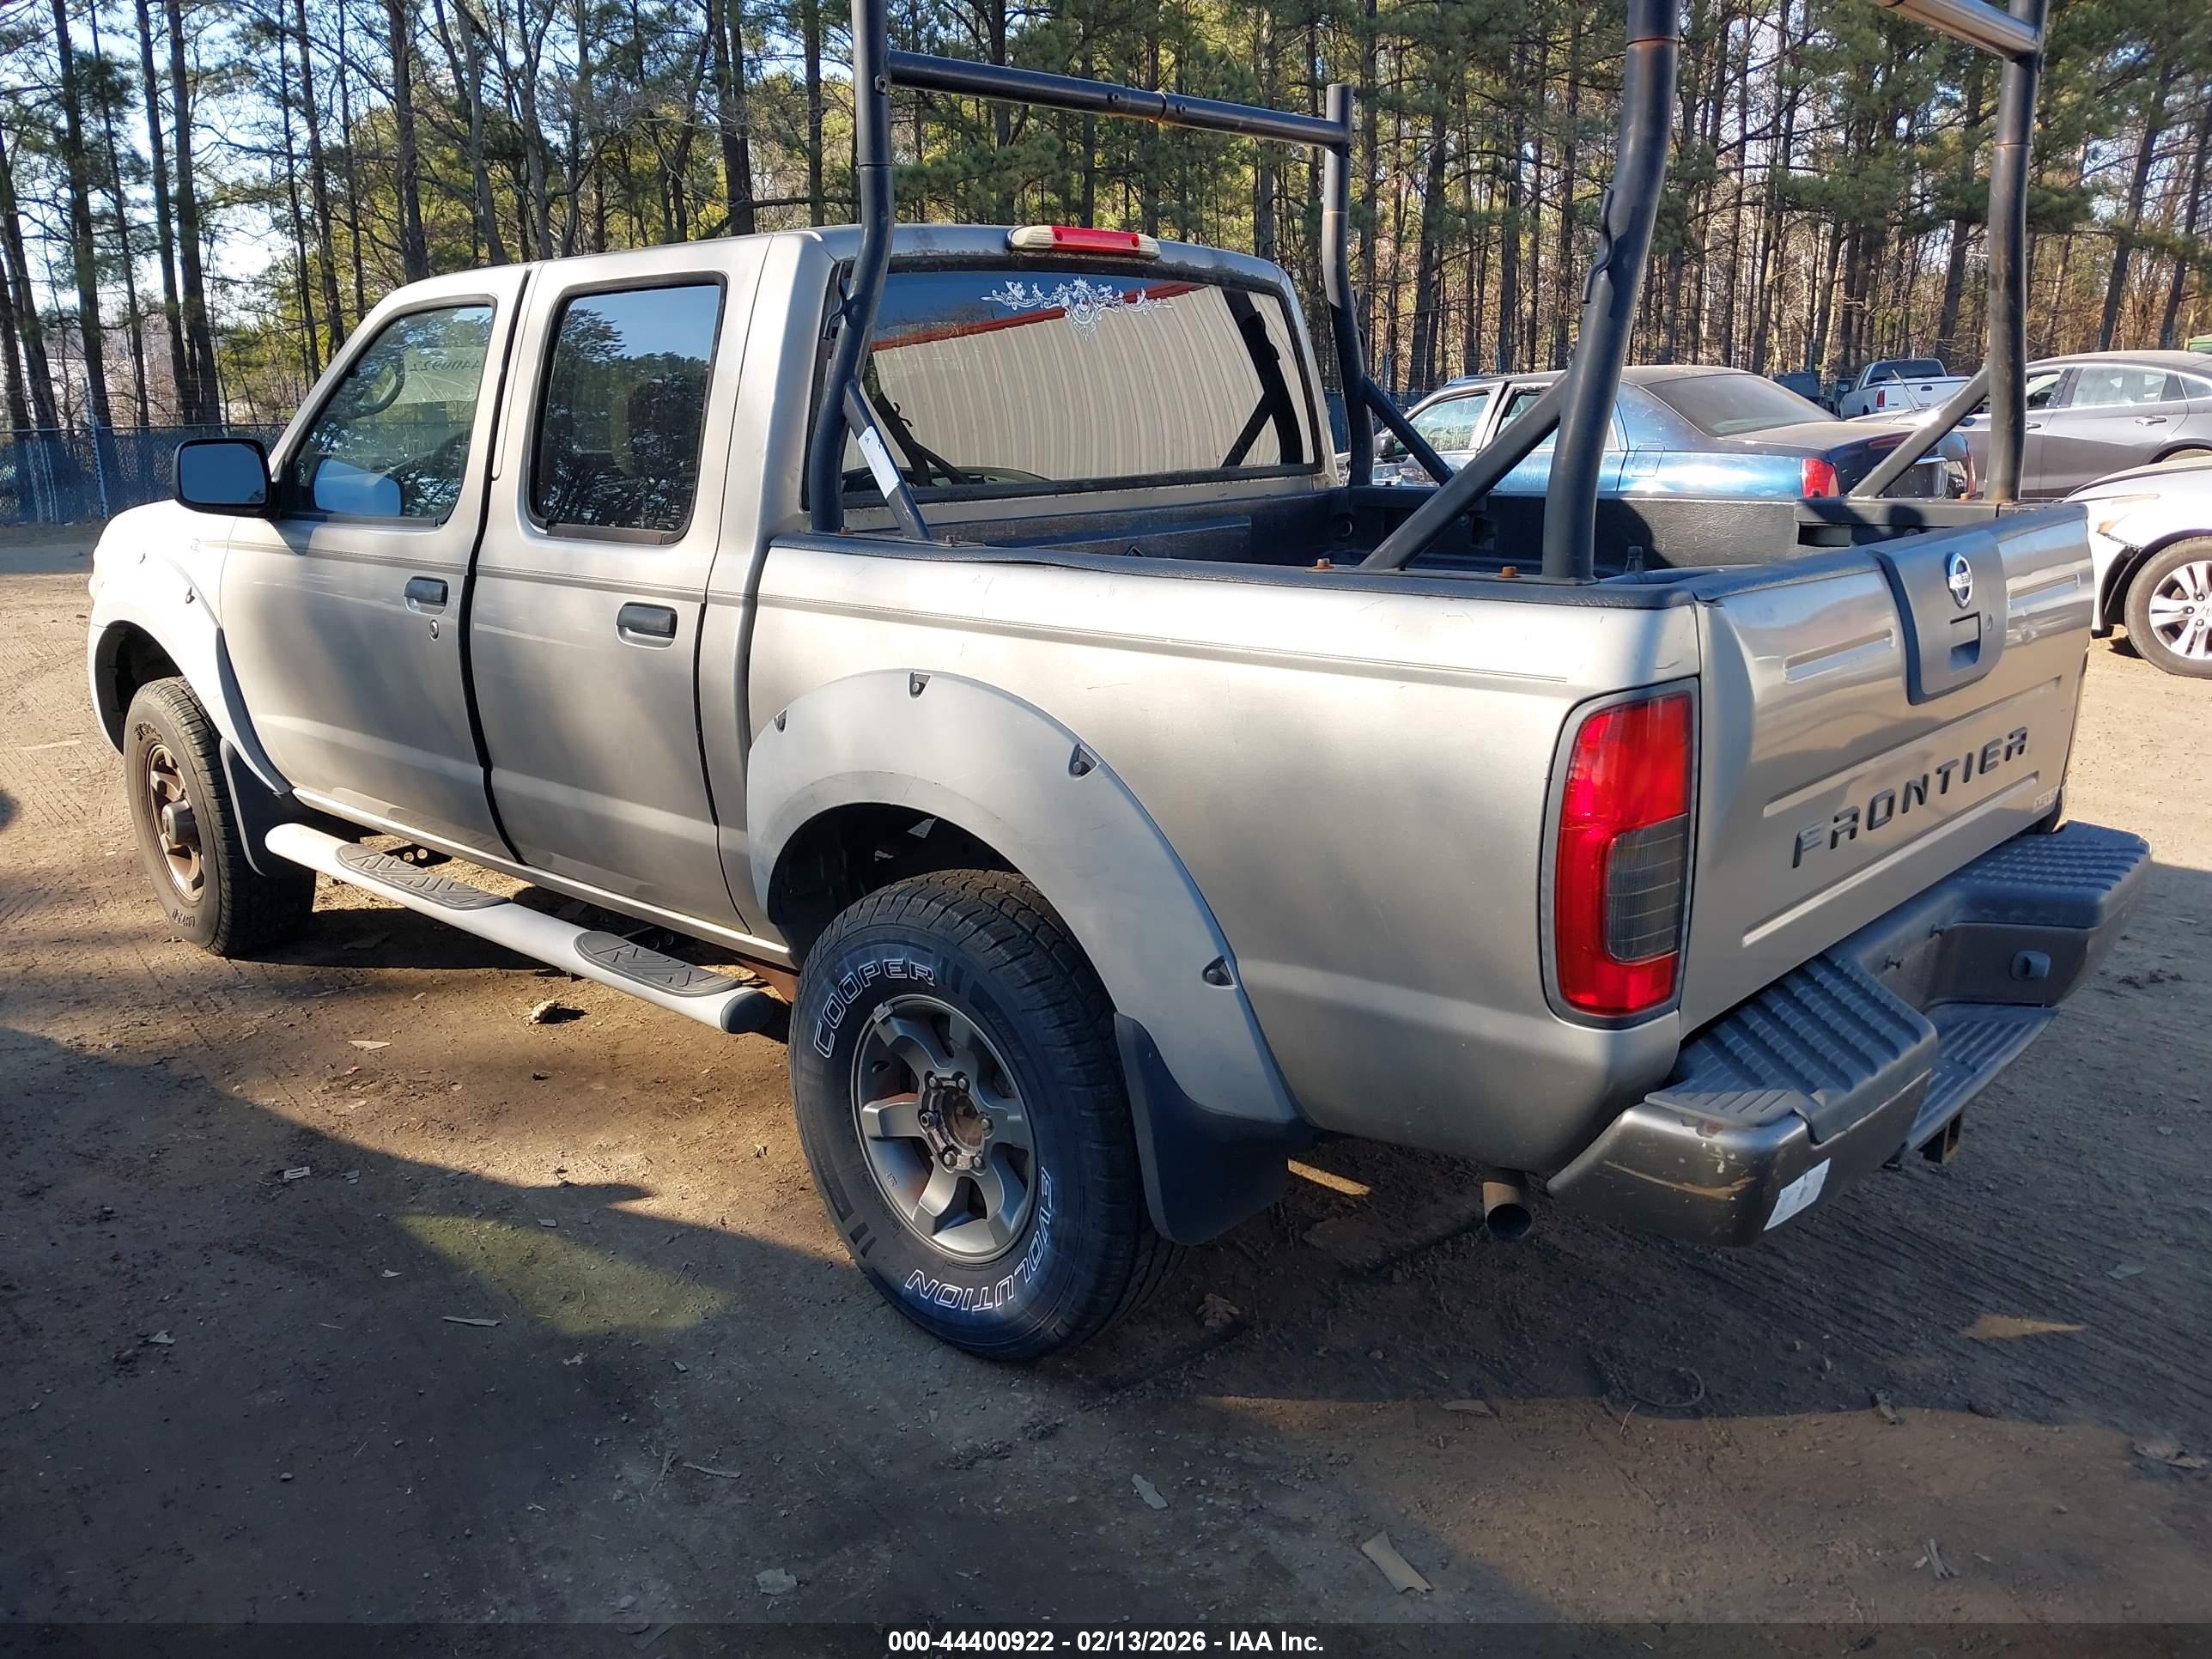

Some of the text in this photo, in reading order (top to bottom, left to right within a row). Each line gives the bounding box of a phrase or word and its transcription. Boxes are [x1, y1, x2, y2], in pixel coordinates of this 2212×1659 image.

[1792, 726, 2028, 869] FRONTIER
[813, 957, 936, 1059] COOPER
[904, 1164, 1054, 1313] EVOLUTION
